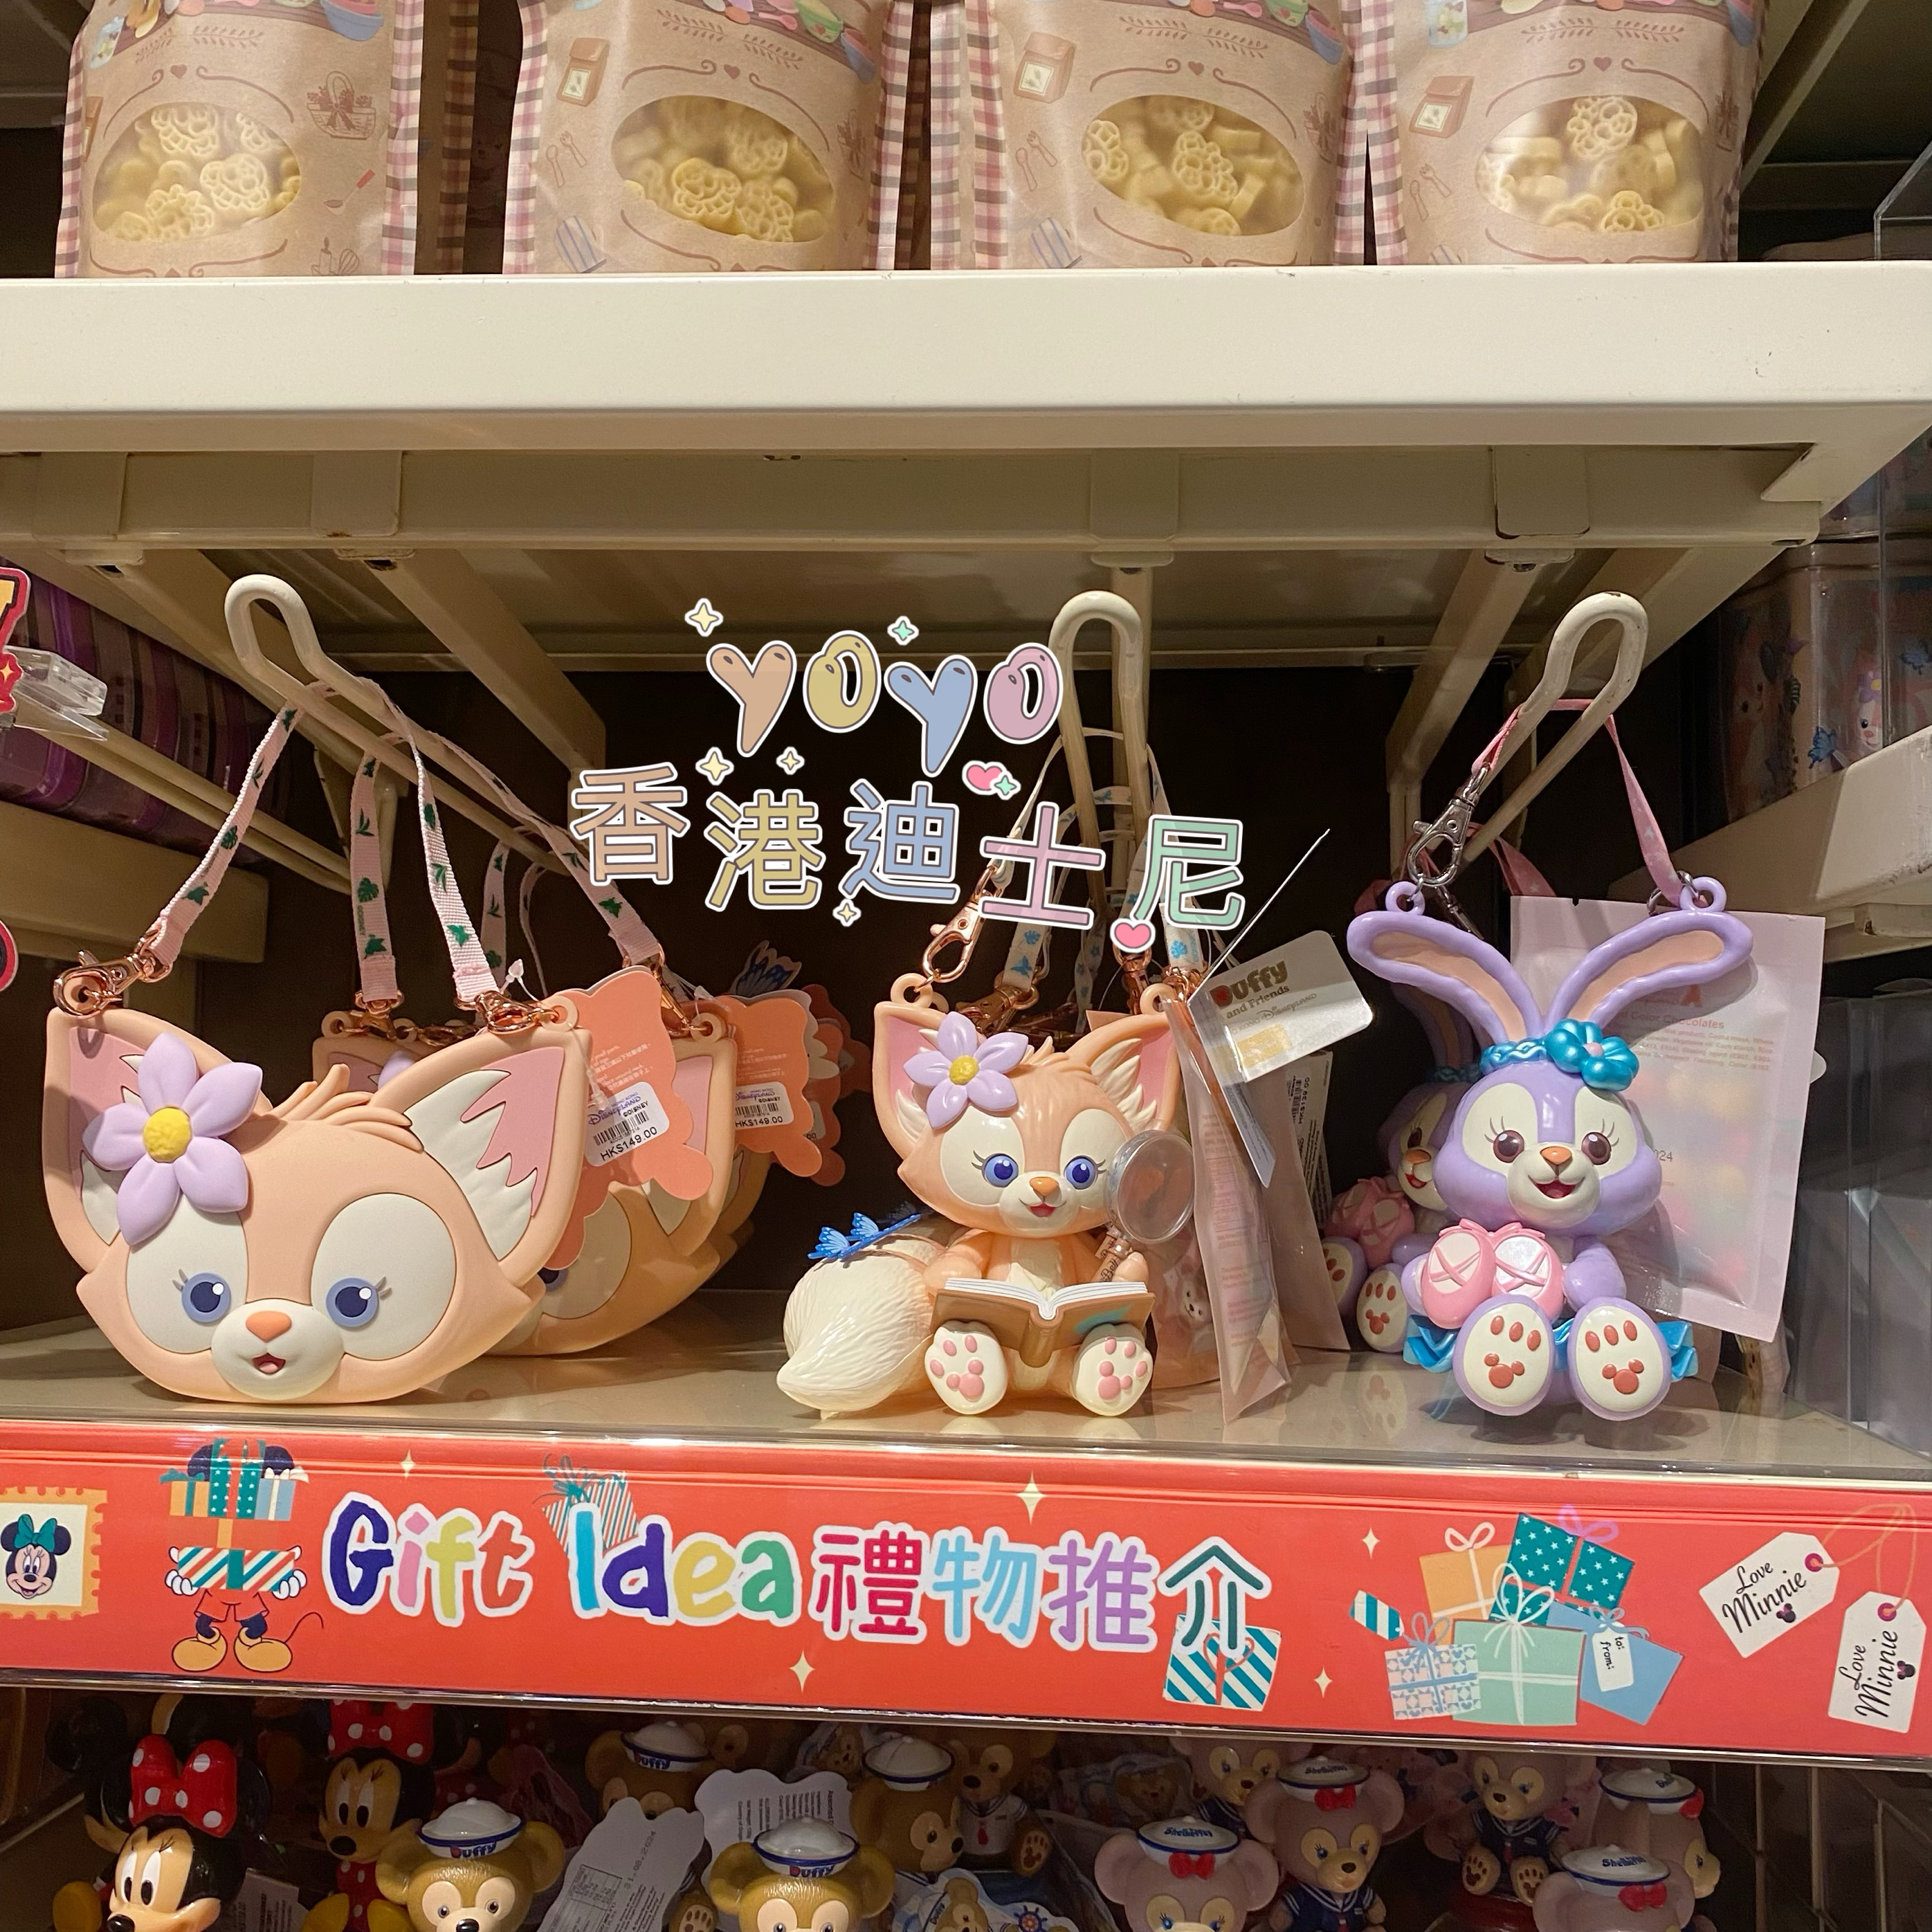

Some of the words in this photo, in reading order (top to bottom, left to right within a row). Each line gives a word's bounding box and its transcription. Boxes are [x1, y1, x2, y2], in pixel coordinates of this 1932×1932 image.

[1226, 1003, 1248, 1019] and
[1247, 985, 1290, 1009] Friends
[600, 1127, 657, 1161] HK$149.00
[323, 1492, 535, 1628] Gift
[567, 1502, 803, 1628] Idea
[809, 1520, 1271, 1657] 禮物推介
[1735, 1562, 1774, 1595] Love
[1722, 1569, 1807, 1634] Minnie
[1600, 1641, 1614, 1670] from:
[1838, 1645, 1866, 1690] Love
[1854, 1630, 1898, 1717] Minnie
[450, 1841, 497, 1859] Duffy
[790, 1864, 835, 1877] Duffy
